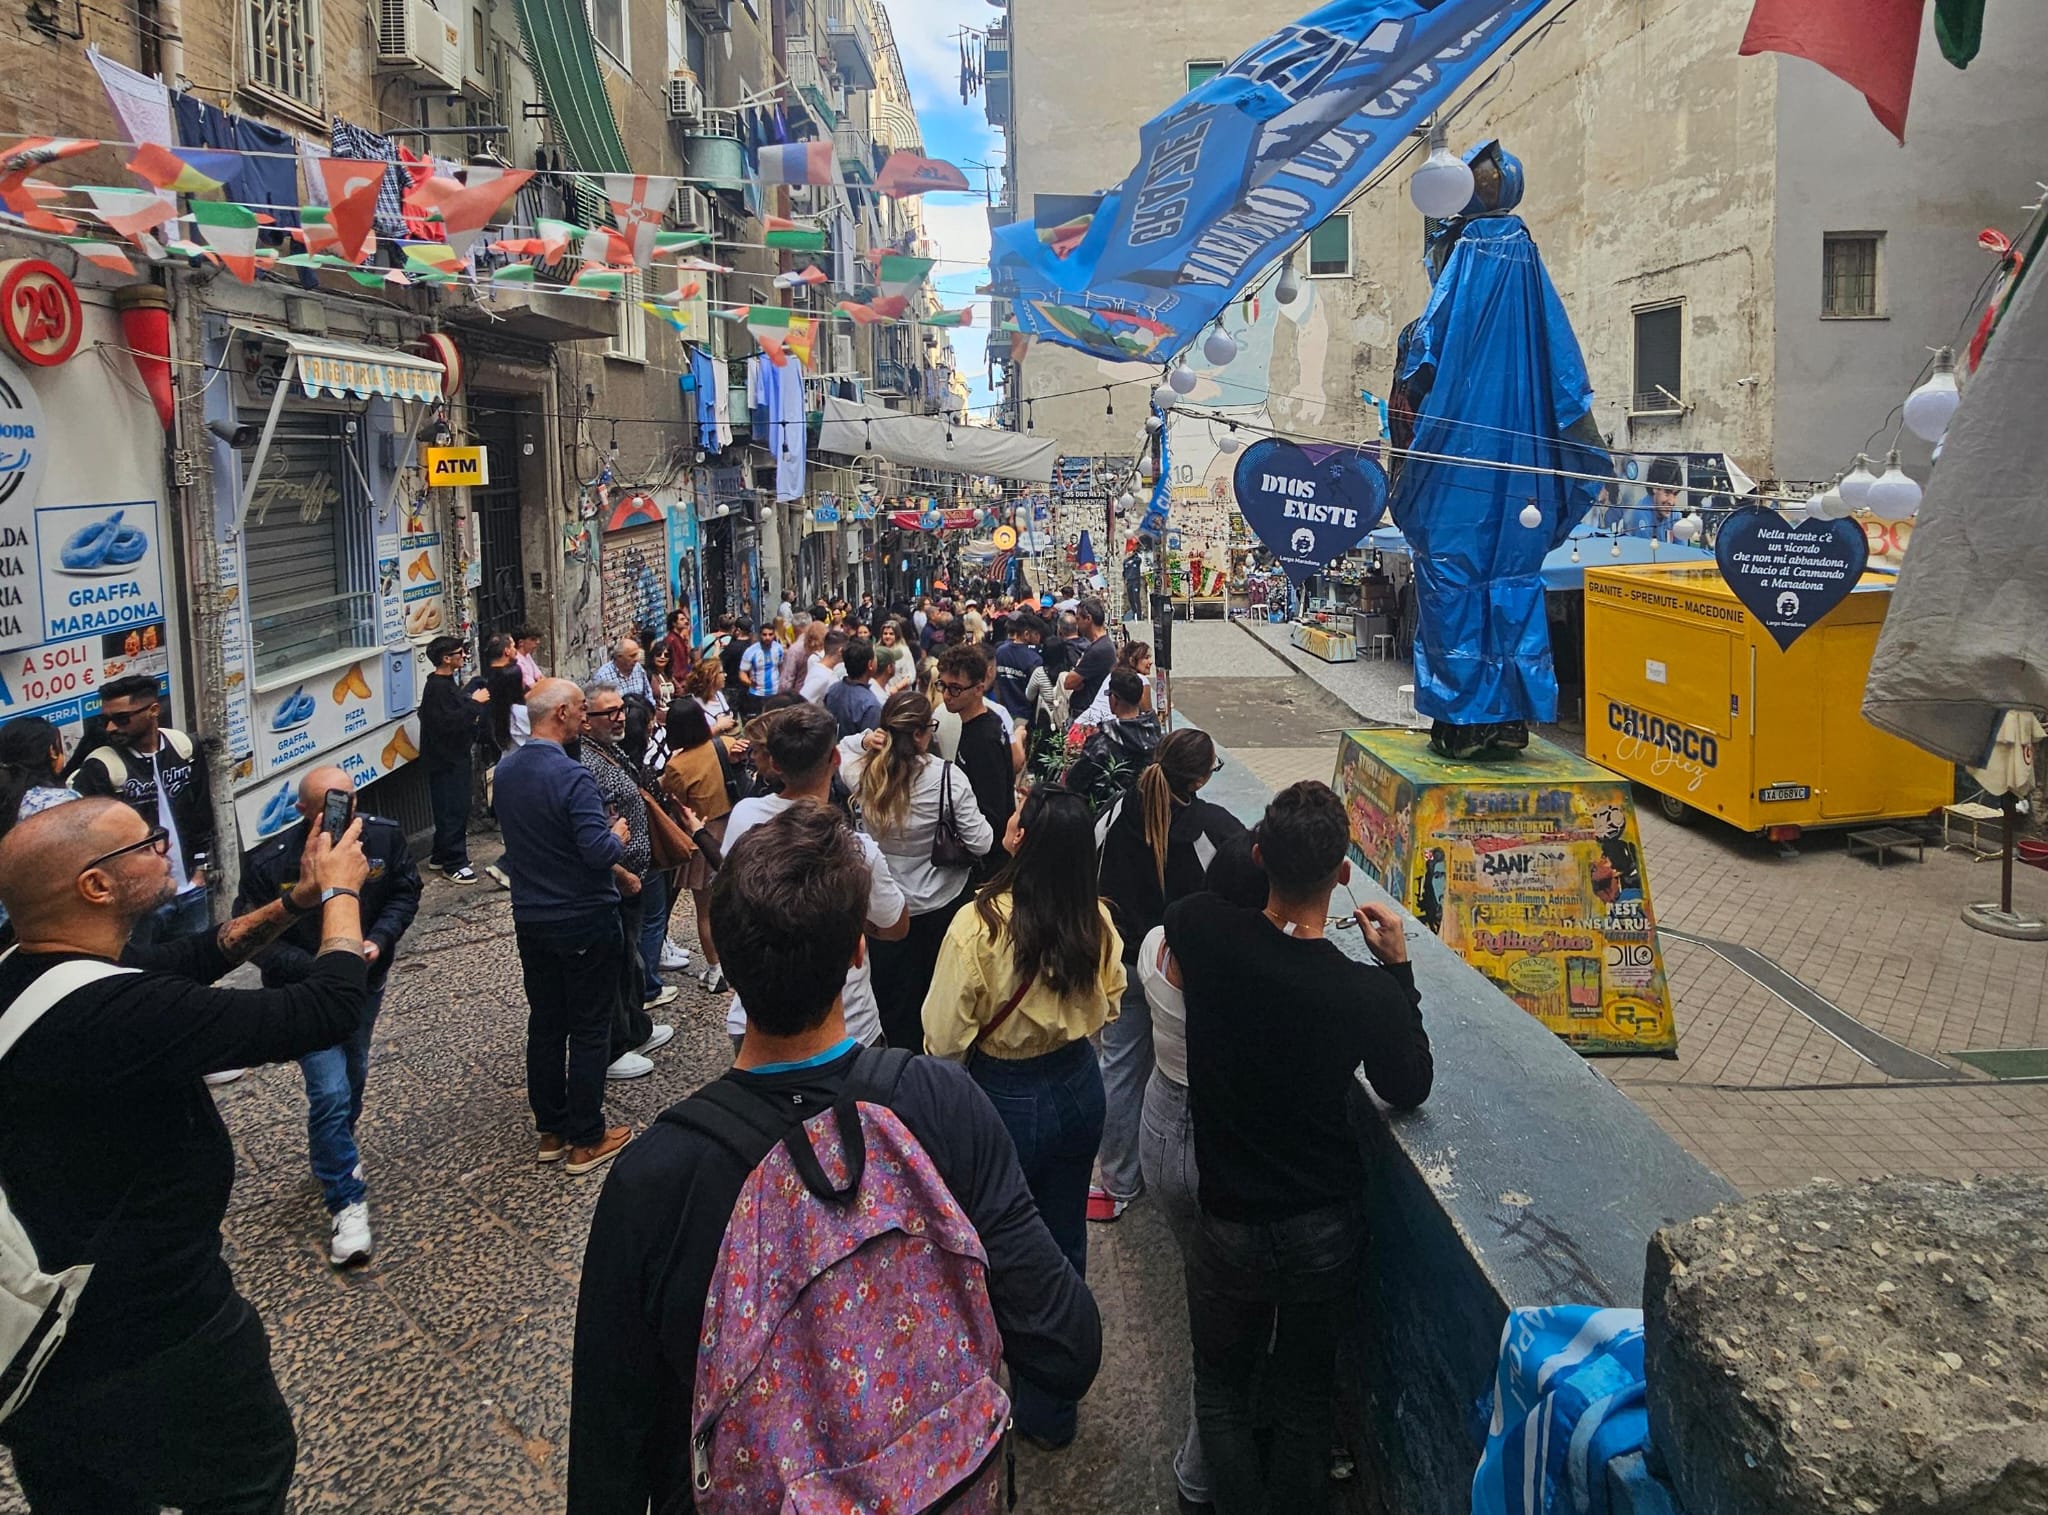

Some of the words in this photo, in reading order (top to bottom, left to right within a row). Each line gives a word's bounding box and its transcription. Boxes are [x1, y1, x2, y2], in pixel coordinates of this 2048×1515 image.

[17, 283, 66, 343] 29
[0, 423, 35, 441] ona
[435, 458, 477, 474] ATM
[1283, 499, 1358, 528] EXISTE
[1758, 528, 1785, 540] Nella
[1786, 532, 1817, 542] mente
[1733, 552, 1751, 562] che
[1752, 555, 1772, 563] non
[1773, 554, 1787, 563] mi
[1768, 543, 1782, 551] un
[1784, 542, 1820, 554] ricordo
[1750, 565, 1777, 575] bacio
[1779, 566, 1790, 576] di
[1793, 567, 1845, 579] Carmando
[69, 581, 141, 608] GRAFFA
[1760, 579, 1768, 587] a
[1771, 578, 1824, 591] Maradona
[1588, 581, 1622, 598] GRANITE
[1631, 590, 1678, 609] SPREMUTE
[1684, 600, 1744, 624] MACEDONIE
[51, 601, 158, 637] MARADONA
[22, 657, 37, 677] A
[43, 645, 87, 671] SOLI
[22, 671, 76, 702] 10,00
[83, 668, 95, 686] €
[345, 707, 366, 722] PIZZA
[345, 718, 368, 734] FRITTA
[278, 731, 309, 751] GRAFFA
[271, 741, 317, 767] MARADONA
[336, 753, 365, 773] FFA
[1651, 734, 1708, 791] Diez
